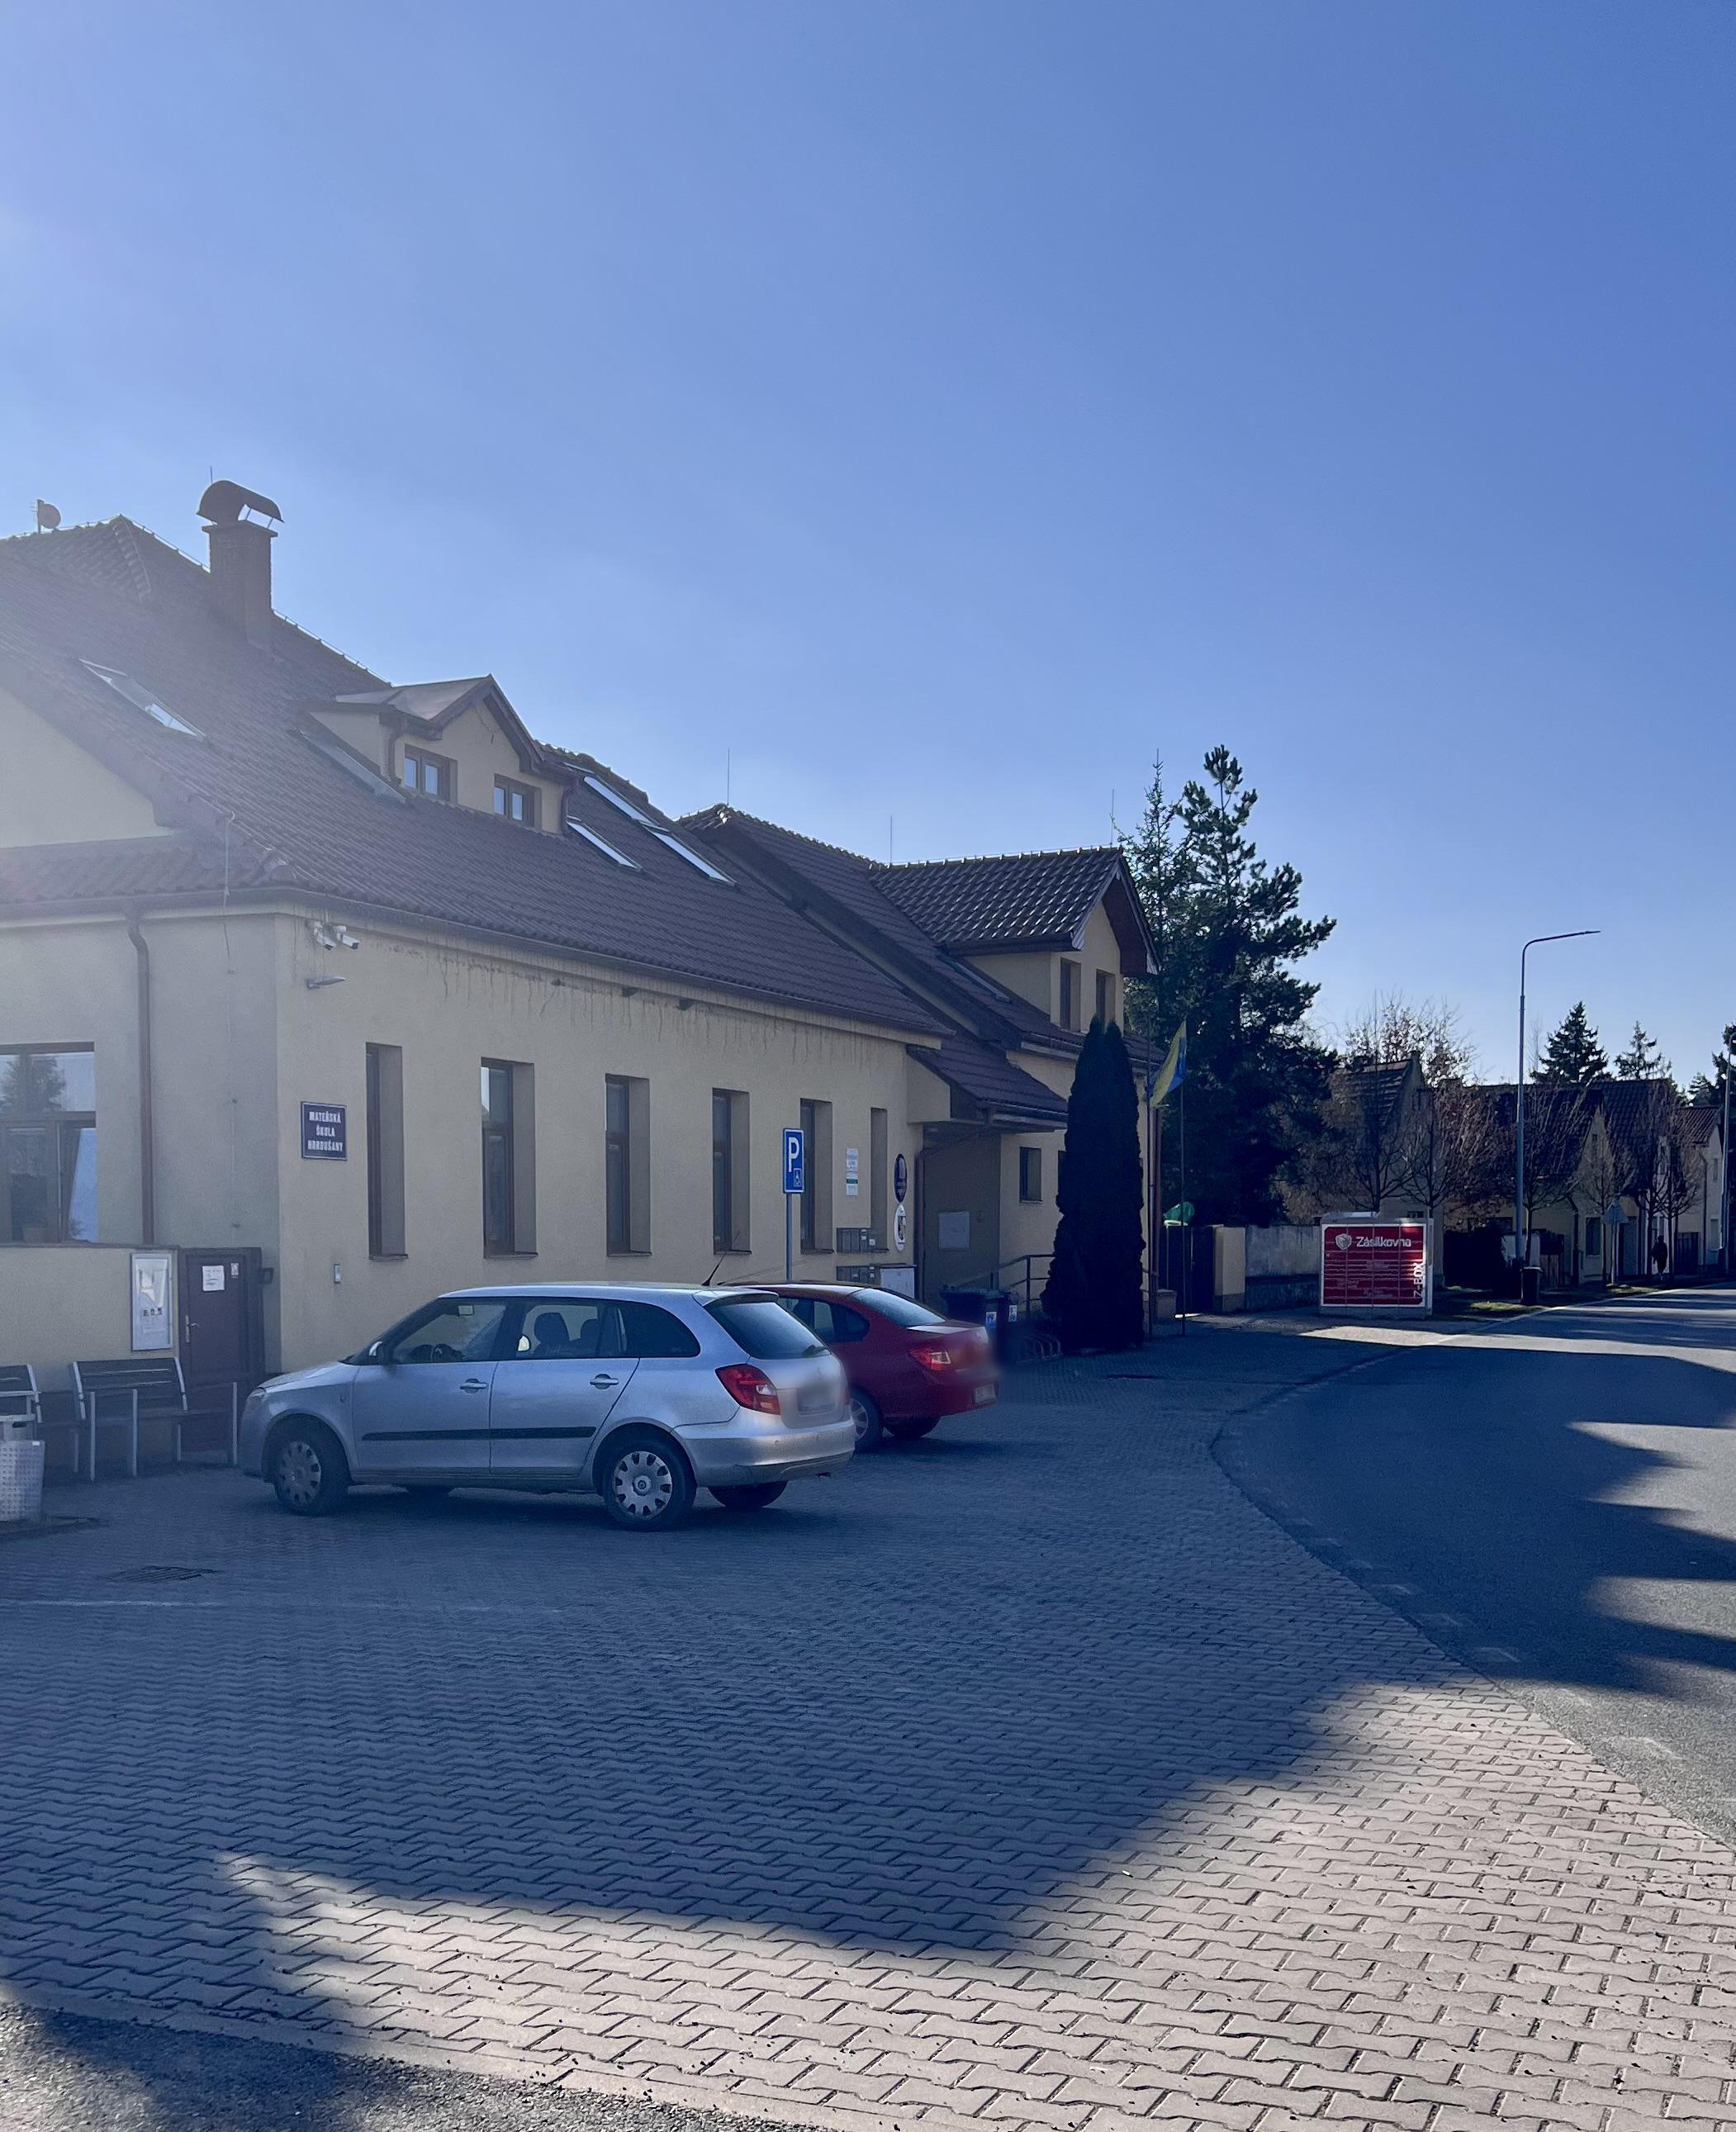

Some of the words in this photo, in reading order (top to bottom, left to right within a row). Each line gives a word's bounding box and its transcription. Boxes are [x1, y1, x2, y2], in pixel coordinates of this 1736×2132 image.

[315, 1124, 335, 1137] ŠKOLA
[788, 1137, 800, 1172] P
[1355, 1236, 1411, 1247] Zásilkovna
